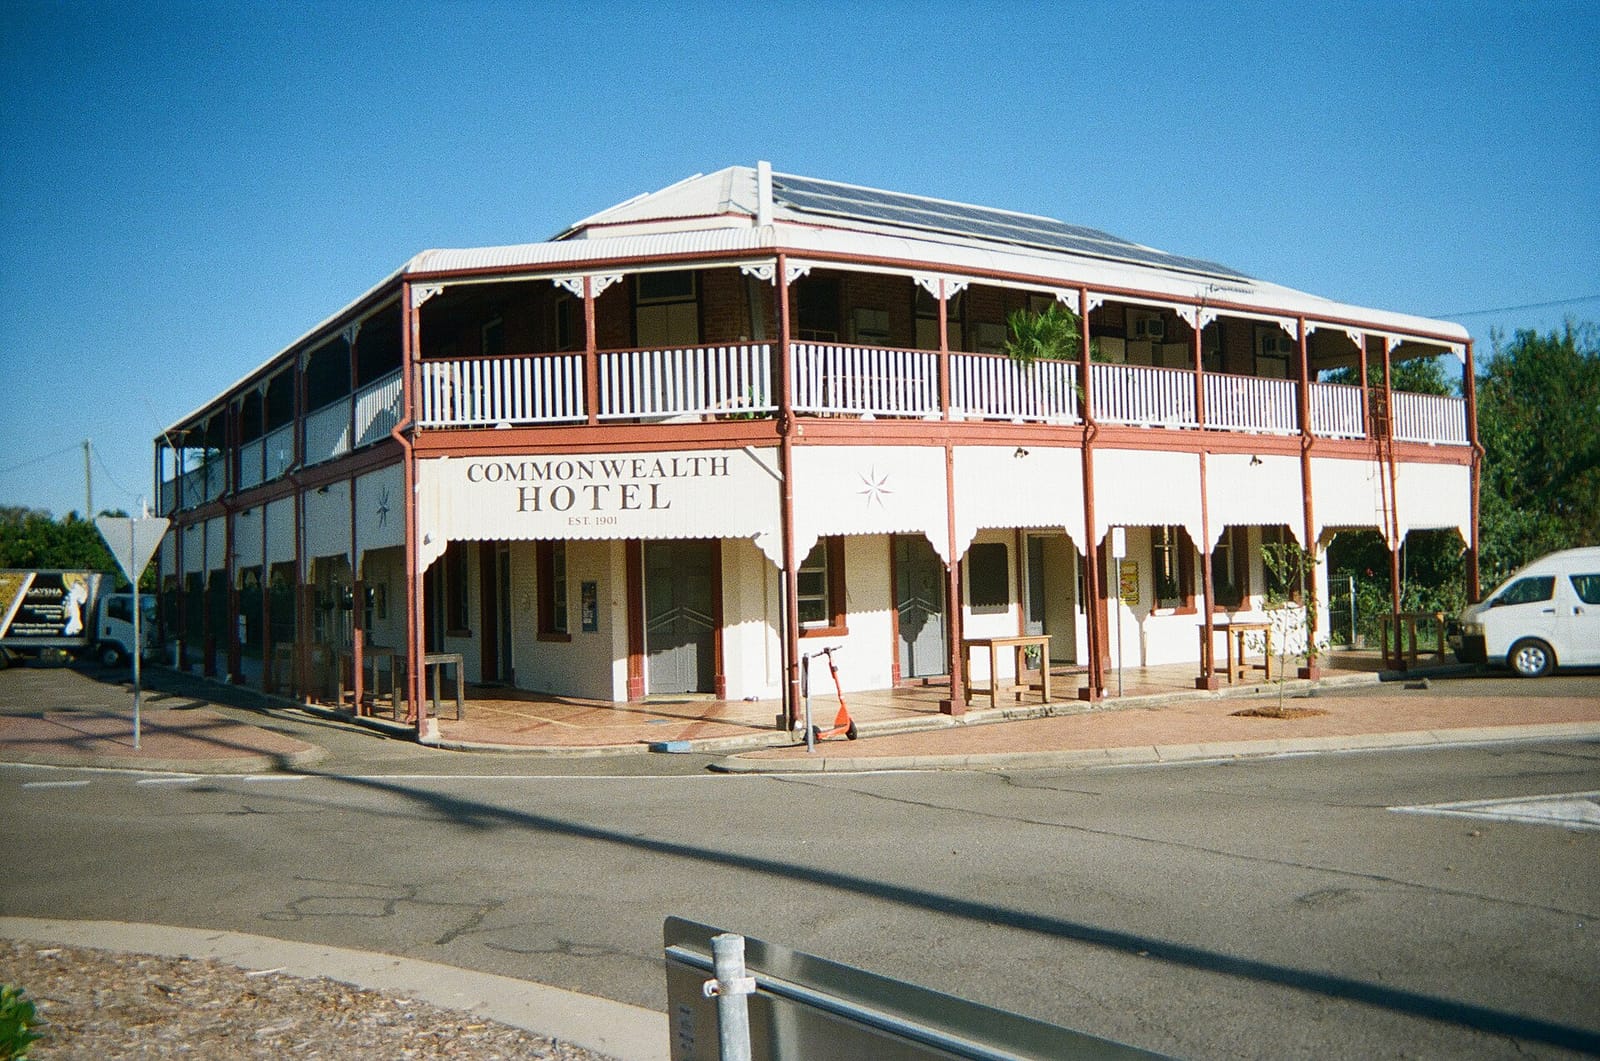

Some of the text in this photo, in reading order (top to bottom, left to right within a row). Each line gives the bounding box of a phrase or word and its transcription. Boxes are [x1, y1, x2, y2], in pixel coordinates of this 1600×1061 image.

[467, 456, 730, 482] COMMONWEALTH
[517, 484, 672, 512] HOTEL
[568, 516, 618, 526] EST. 1901
